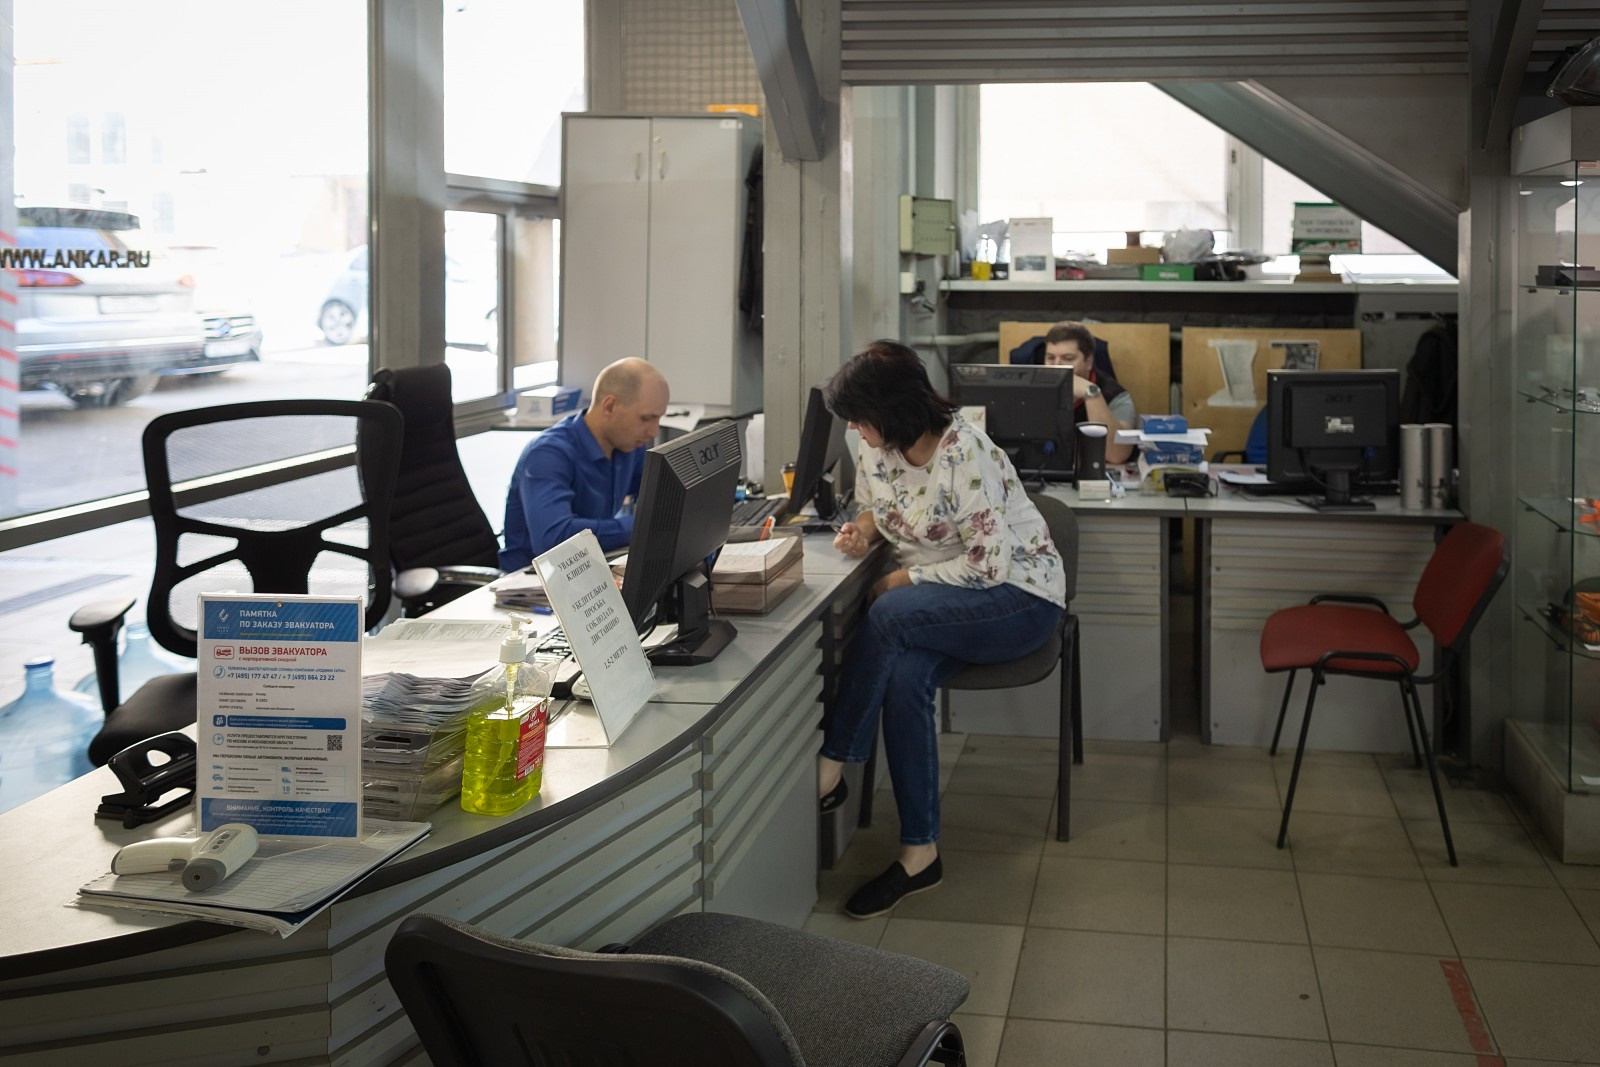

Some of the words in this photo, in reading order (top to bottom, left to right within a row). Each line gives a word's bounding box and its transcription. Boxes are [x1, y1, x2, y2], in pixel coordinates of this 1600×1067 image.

[699, 442, 719, 465] acer
[571, 581, 608, 612] УБЕДИТЕЛЬНАЯ
[584, 598, 606, 618] ПРОСЬБА
[239, 609, 278, 618] ПАМЯТКА
[239, 620, 250, 628] ПО
[252, 620, 283, 629] ЗАКАЗУ
[284, 621, 335, 630] ЭВАКУАТОРА
[239, 646, 270, 655] ВЫЗОВ
[272, 647, 328, 656] ЭВАКУАТОРА
[226, 804, 262, 812] ВНИМАНИЕ,
